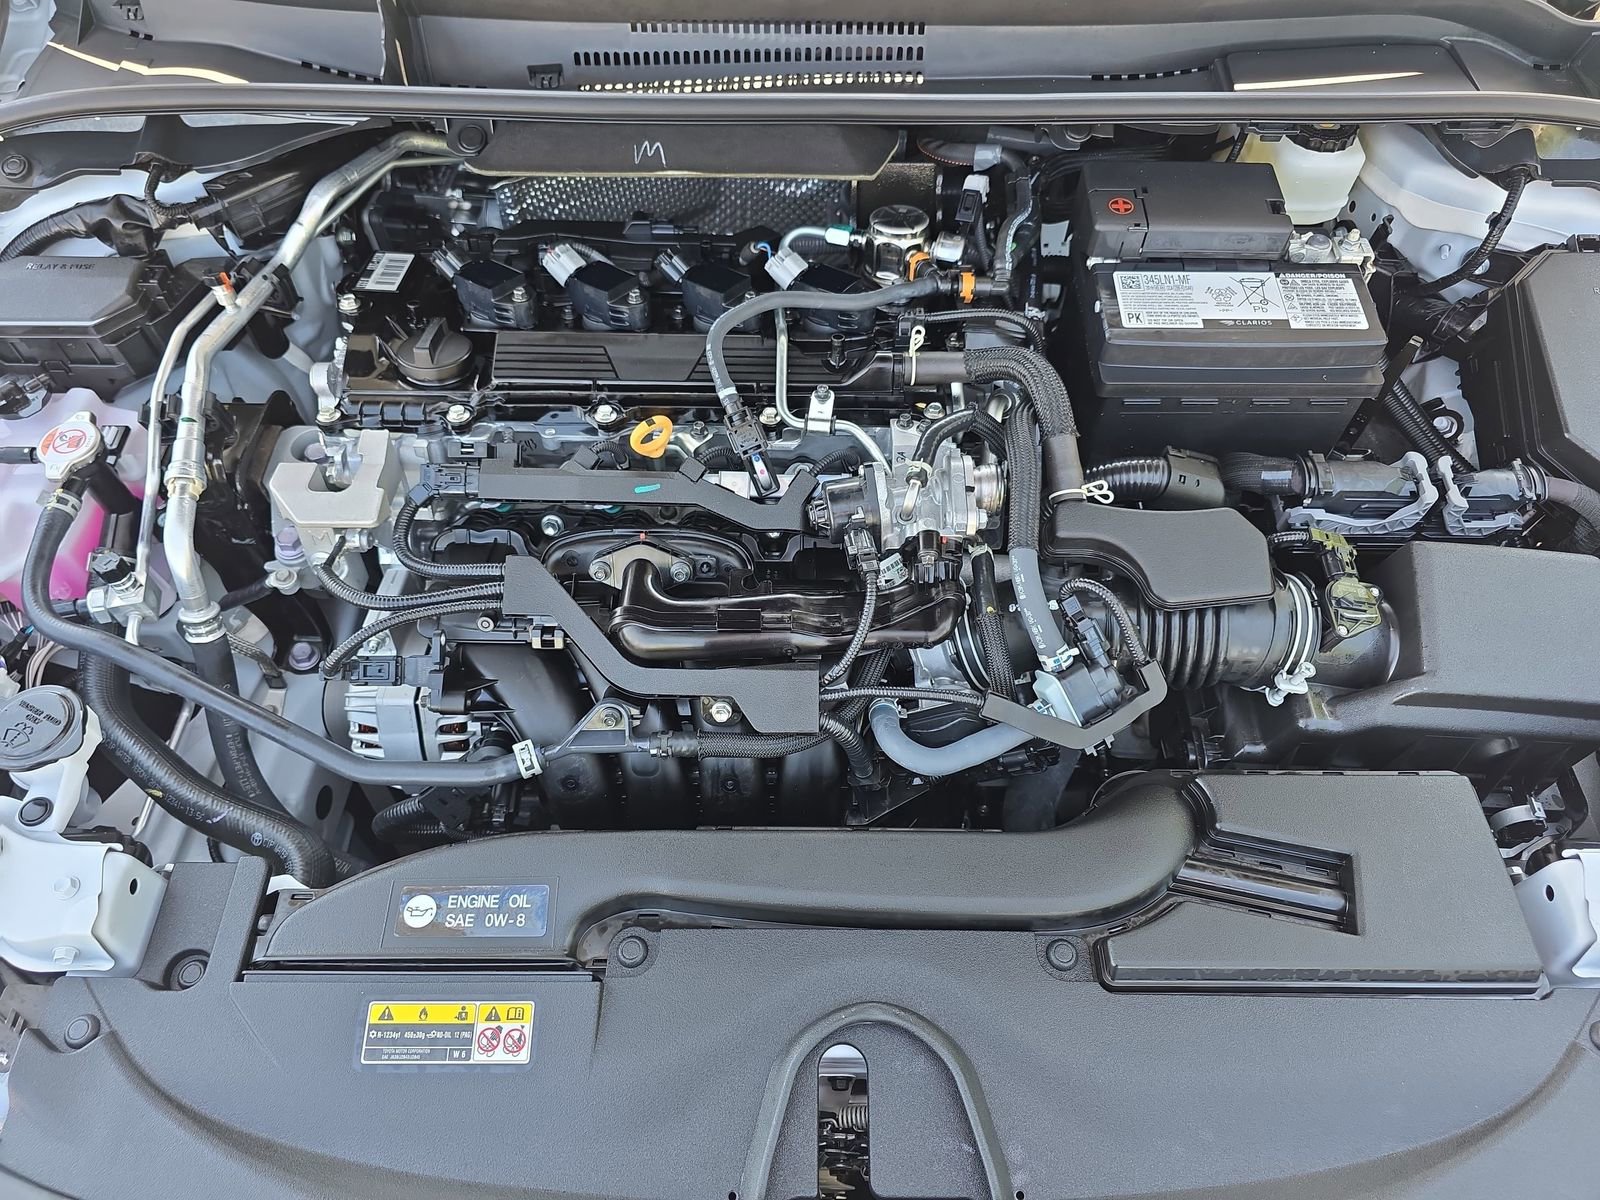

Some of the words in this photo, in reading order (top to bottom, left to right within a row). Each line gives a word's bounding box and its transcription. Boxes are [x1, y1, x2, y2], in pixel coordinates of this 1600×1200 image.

[1143, 274, 1191, 285] 345LN1-MF
[1253, 305, 1268, 313] Pb
[1127, 312, 1143, 324] PK
[447, 894, 500, 909] ENGINE
[508, 894, 532, 909] OIL
[445, 913, 475, 928] SAE
[485, 913, 526, 928] 0W-8
[453, 1050, 460, 1058] W
[461, 1050, 466, 1058] 6
